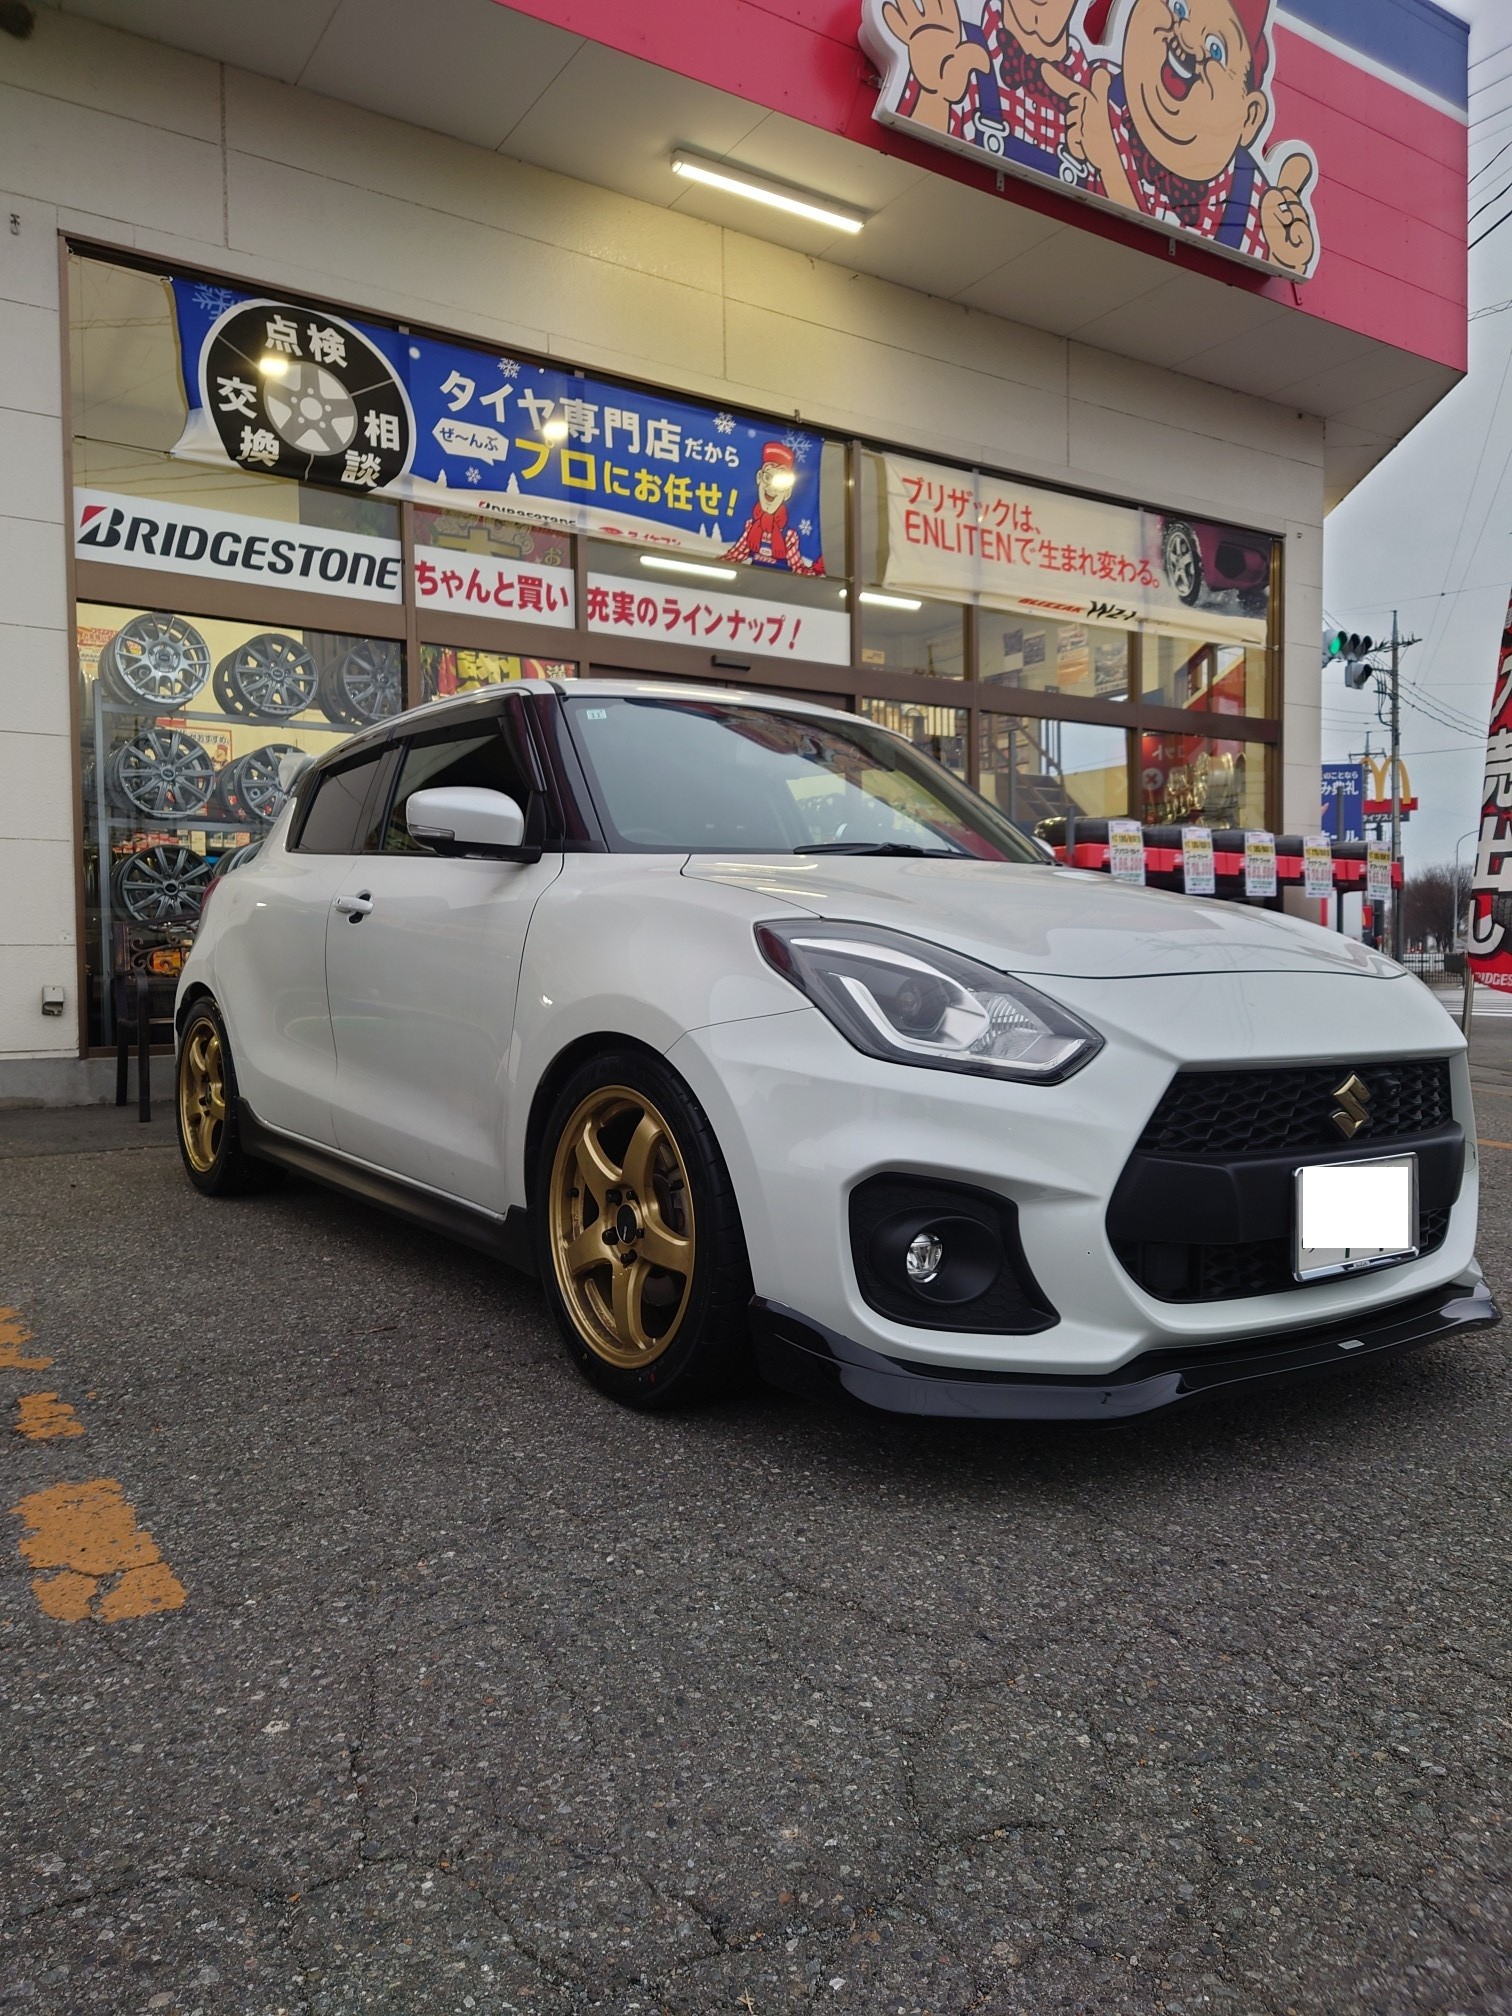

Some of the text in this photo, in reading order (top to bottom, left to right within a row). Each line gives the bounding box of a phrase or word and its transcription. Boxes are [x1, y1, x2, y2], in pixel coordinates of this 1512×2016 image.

[265, 314, 348, 368] 点検
[216, 376, 280, 467] 交換
[341, 409, 400, 487] 相談
[439, 370, 740, 467] タイヤ専門店だから
[515, 437, 738, 517] プロにお任せ!
[902, 477, 1041, 534] ブリザックは、
[77, 505, 401, 590] BRIDGESTONE
[414, 560, 569, 613] ちゃんと買い
[587, 587, 802, 650] 充実のラインナップ!
